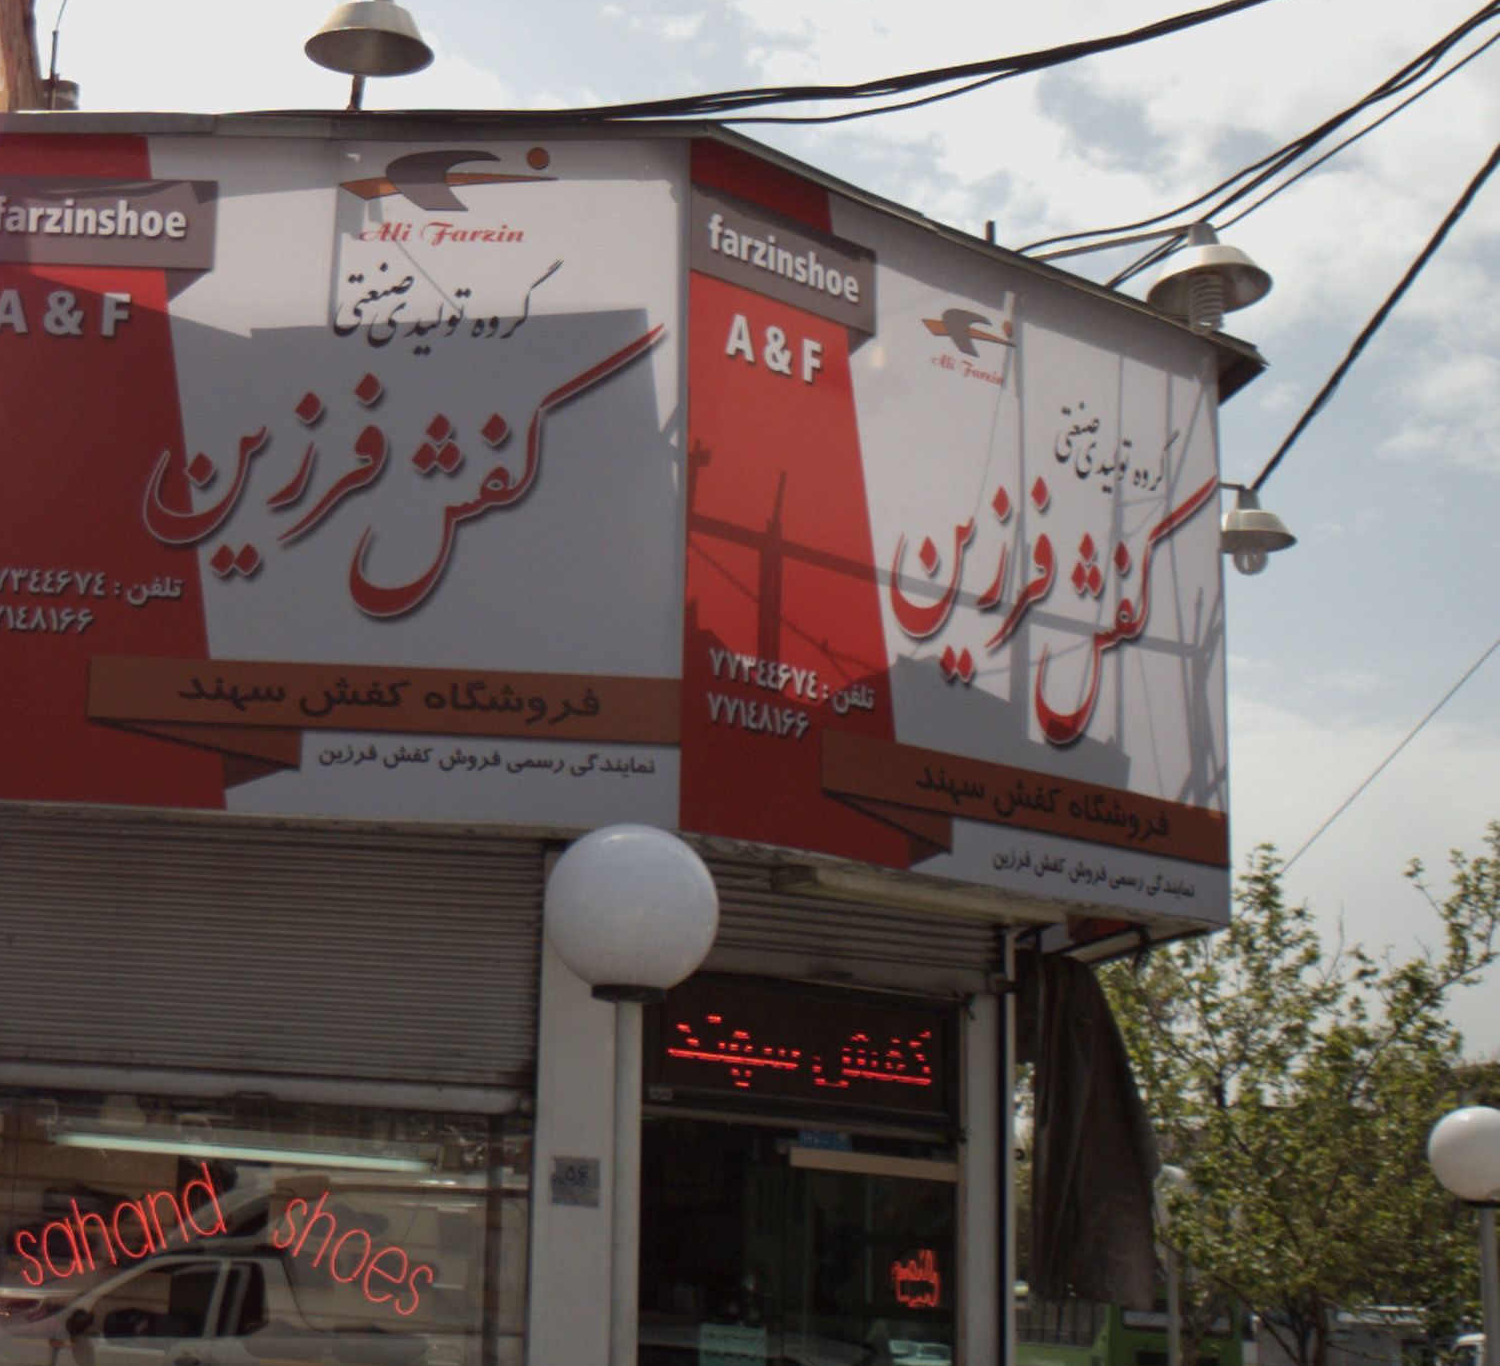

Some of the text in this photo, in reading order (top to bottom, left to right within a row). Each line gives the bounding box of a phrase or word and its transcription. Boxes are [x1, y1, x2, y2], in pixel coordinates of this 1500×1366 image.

[360, 221, 526, 247] Ali Farzin
[707, 214, 861, 304] farzinshoe
[101, 291, 132, 338] F
[333, 259, 564, 356] گروه تولیدی صنعتی
[725, 313, 756, 364] A
[802, 338, 823, 383] F
[143, 324, 665, 617] کفش فرزین
[891, 474, 1219, 745] کفش فرزین
[178, 676, 602, 725] فروشگاه کفش سهند
[318, 745, 656, 778] نمایندگی رسمی فروش کفش فرزین
[915, 768, 1170, 841] فروشگاه کفش سهند
[992, 850, 1032, 871] فرزین
[1033, 857, 1066, 878] کفش
[1067, 861, 1108, 885] فروش
[14, 1161, 434, 1316] sahand shoes
